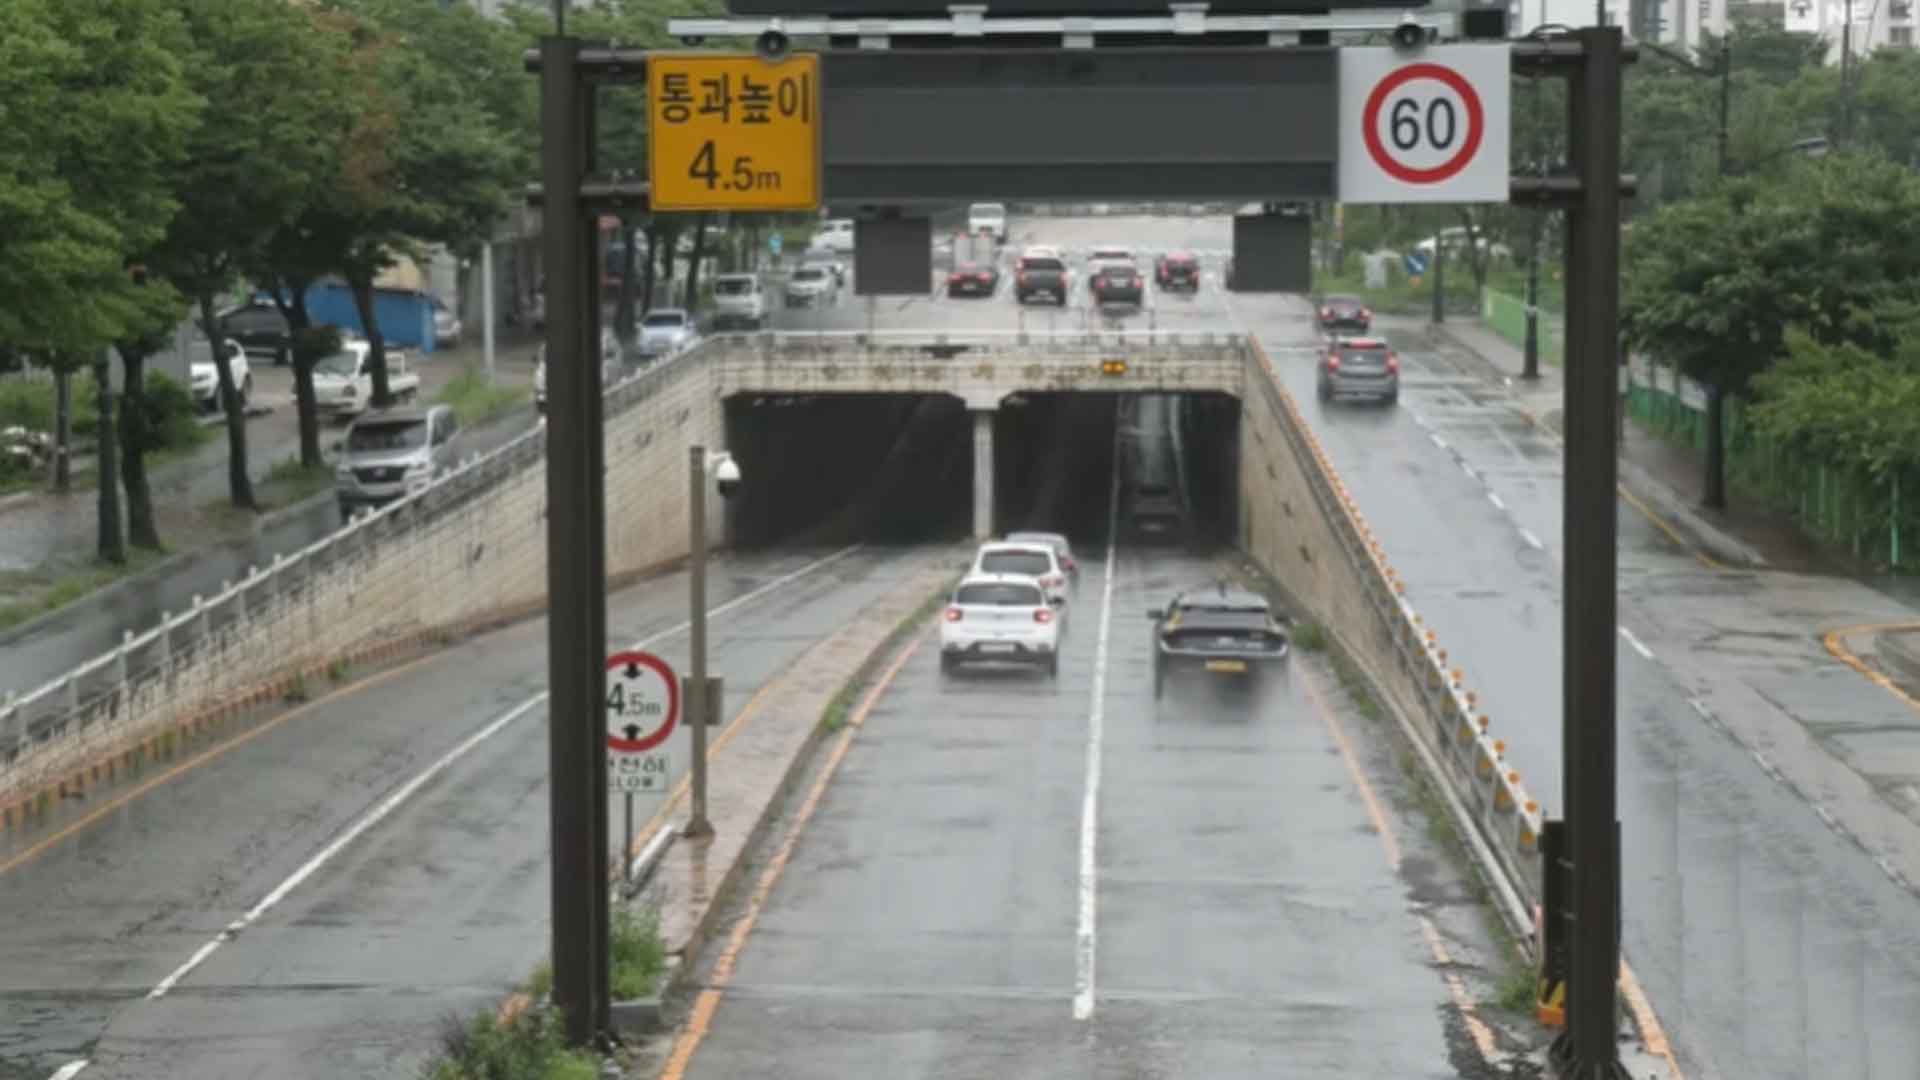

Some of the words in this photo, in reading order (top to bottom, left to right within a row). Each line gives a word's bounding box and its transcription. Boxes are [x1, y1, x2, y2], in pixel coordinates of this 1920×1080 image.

[660, 72, 809, 124] 통과높이
[1391, 97, 1456, 150] 60
[688, 139, 781, 191] 4.5m
